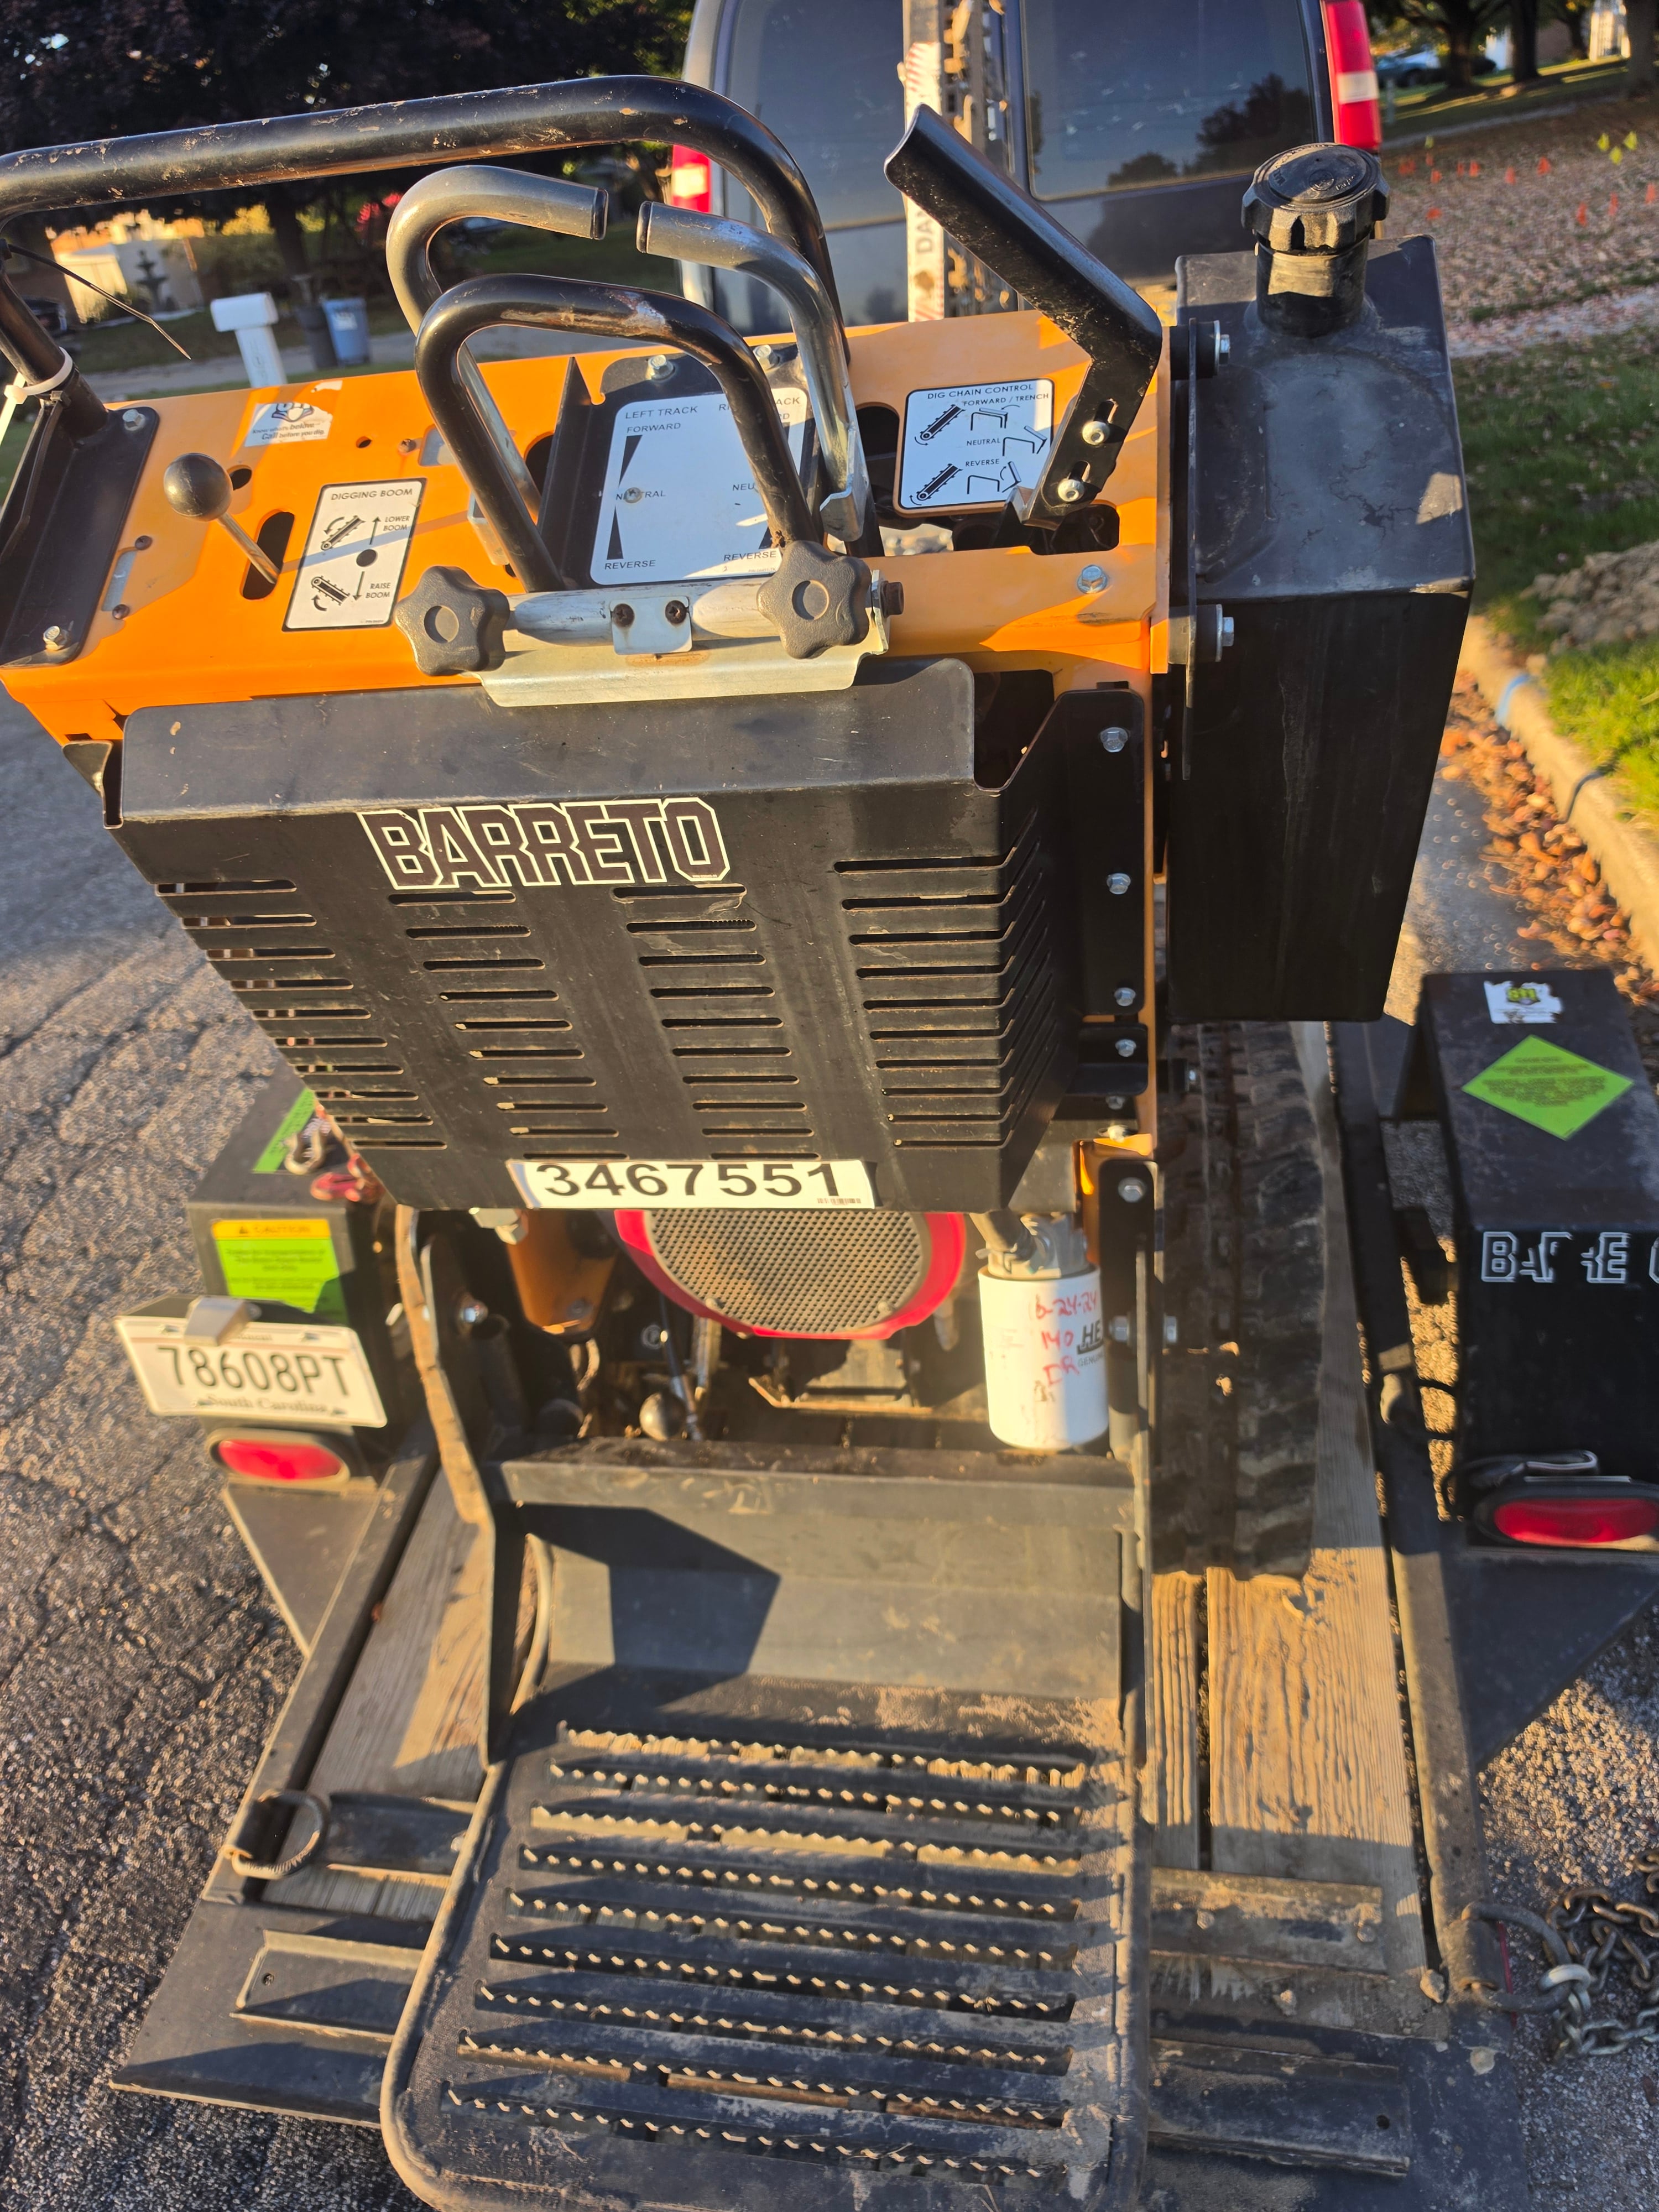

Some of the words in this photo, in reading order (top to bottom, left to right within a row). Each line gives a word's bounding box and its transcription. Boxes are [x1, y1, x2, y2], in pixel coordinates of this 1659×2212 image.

[949, 389, 982, 398] CHAIN
[985, 384, 1034, 394] CONTROL
[963, 397, 1006, 406] FORWARD
[1016, 393, 1049, 401] TRENCH
[625, 410, 654, 419] LEFT
[658, 405, 698, 417] TRACK
[627, 422, 681, 434] FORWARD
[262, 432, 278, 440] Call
[967, 437, 1001, 446] NEUTRAL
[965, 458, 1000, 467] REVERSE
[331, 491, 377, 500] DIGGING
[380, 488, 413, 497] BOOM
[723, 551, 777, 561] REVERSE
[604, 559, 656, 570] REVERSE
[357, 796, 731, 890] BARRETO
[535, 1162, 840, 1197] 3467551
[157, 1344, 349, 1396] 78608PT
[207, 1393, 253, 1408] South
[257, 1397, 328, 1413] Carolina
